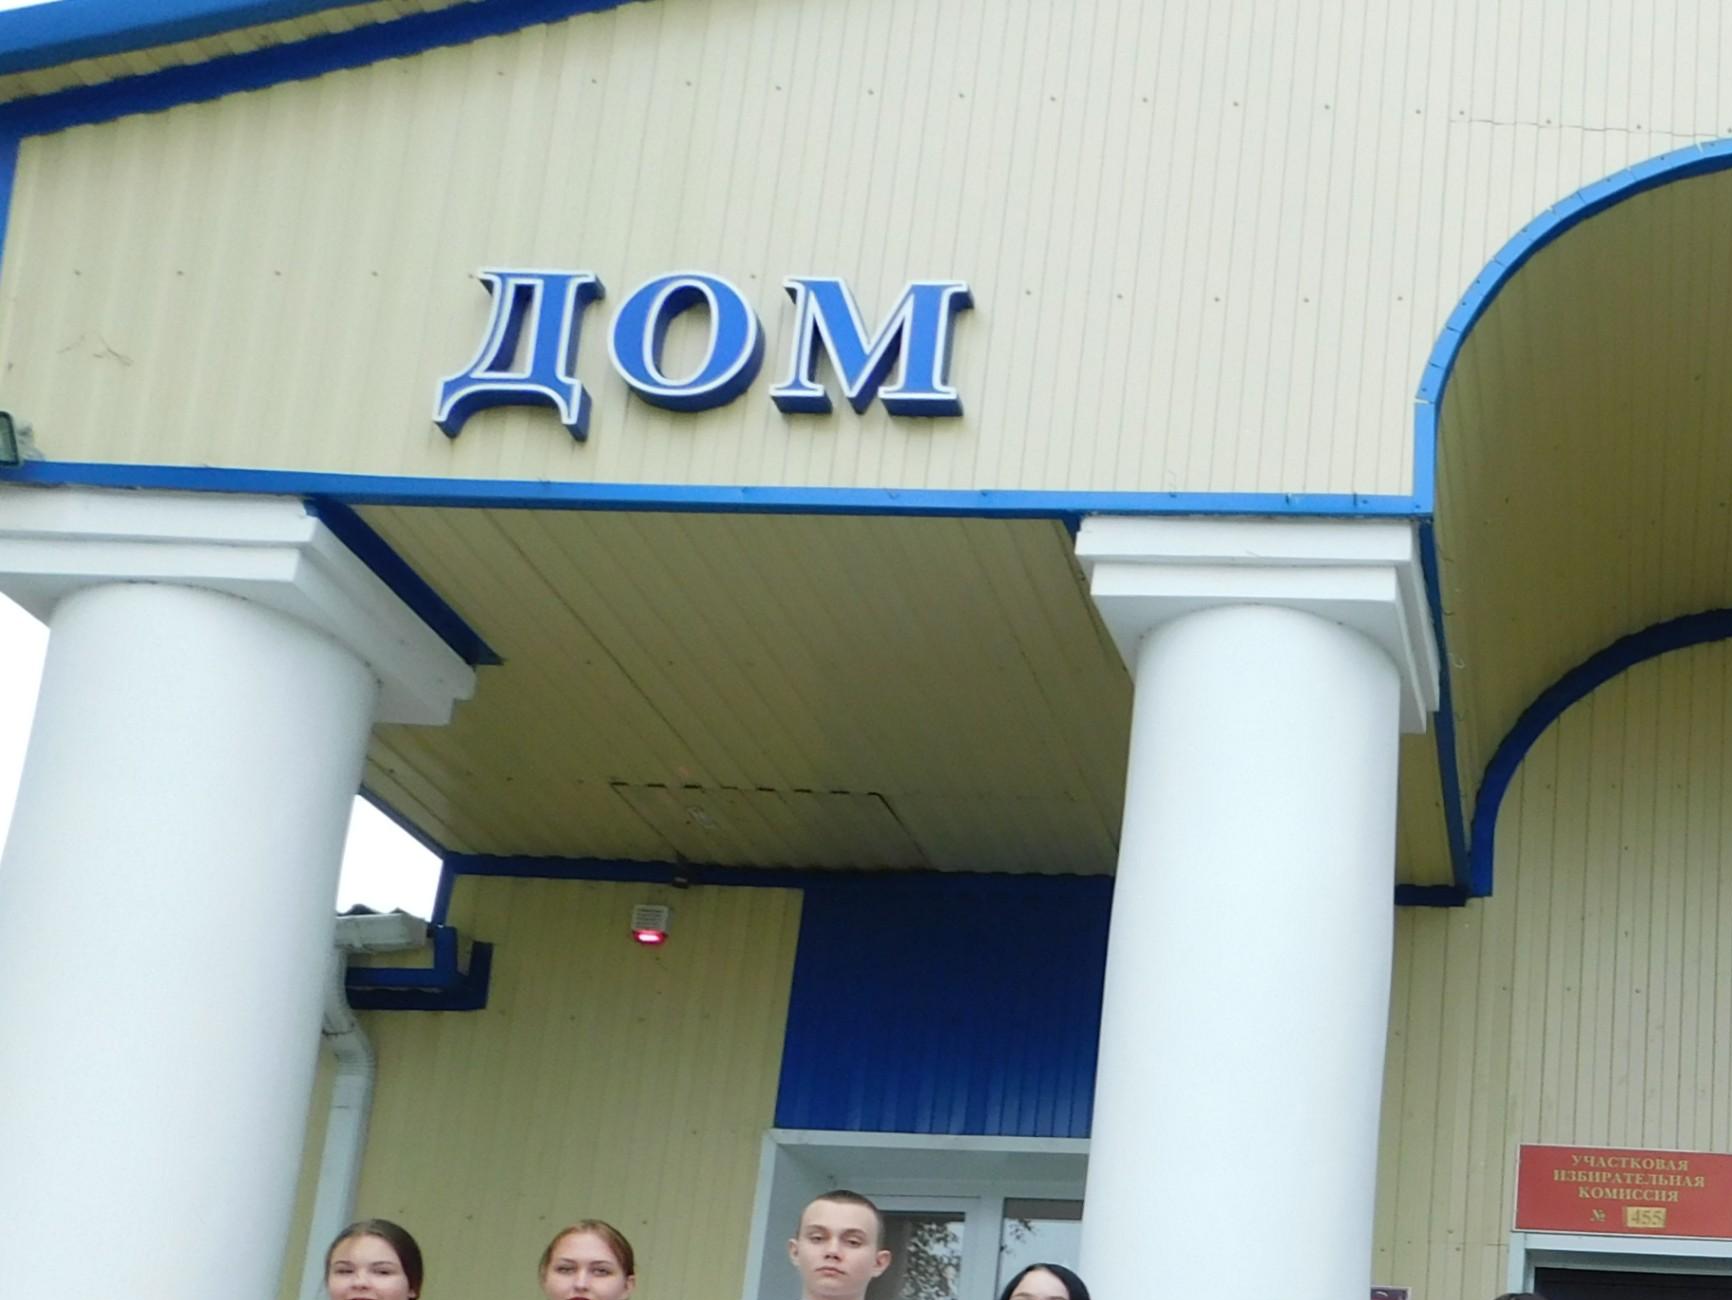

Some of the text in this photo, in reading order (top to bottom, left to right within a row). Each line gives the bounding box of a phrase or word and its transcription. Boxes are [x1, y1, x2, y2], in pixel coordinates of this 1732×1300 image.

[433, 266, 974, 438] ДОМ
[1572, 1155, 1688, 1171] УЧАСТКОВАЯ
[1554, 1170, 1705, 1187] ИЗБИРАТЕЛЬНАЯ
[1578, 1187, 1679, 1202] КОМИССИЯ
[1590, 1208, 1665, 1225] № 455
